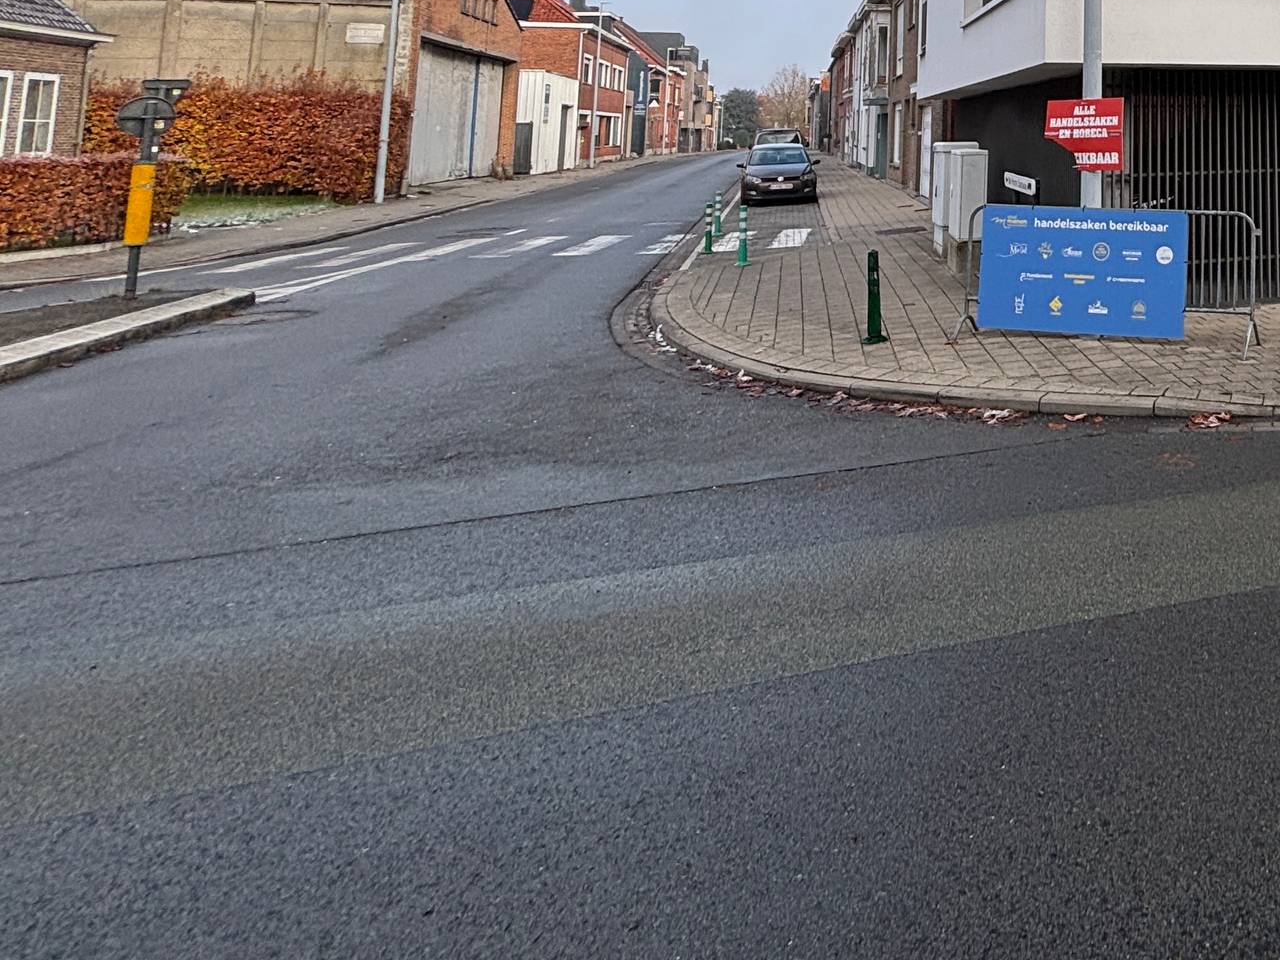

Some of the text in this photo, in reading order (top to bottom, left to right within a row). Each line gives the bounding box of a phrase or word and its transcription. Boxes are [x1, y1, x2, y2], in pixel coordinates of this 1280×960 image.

[1073, 105, 1096, 115] ALLE
[1049, 116, 1119, 128] HANDELSZAKEN
[1058, 128, 1108, 139] EN HORECA
[1034, 217, 1107, 231] handelszaken
[1109, 219, 1169, 232] bereikbaar
